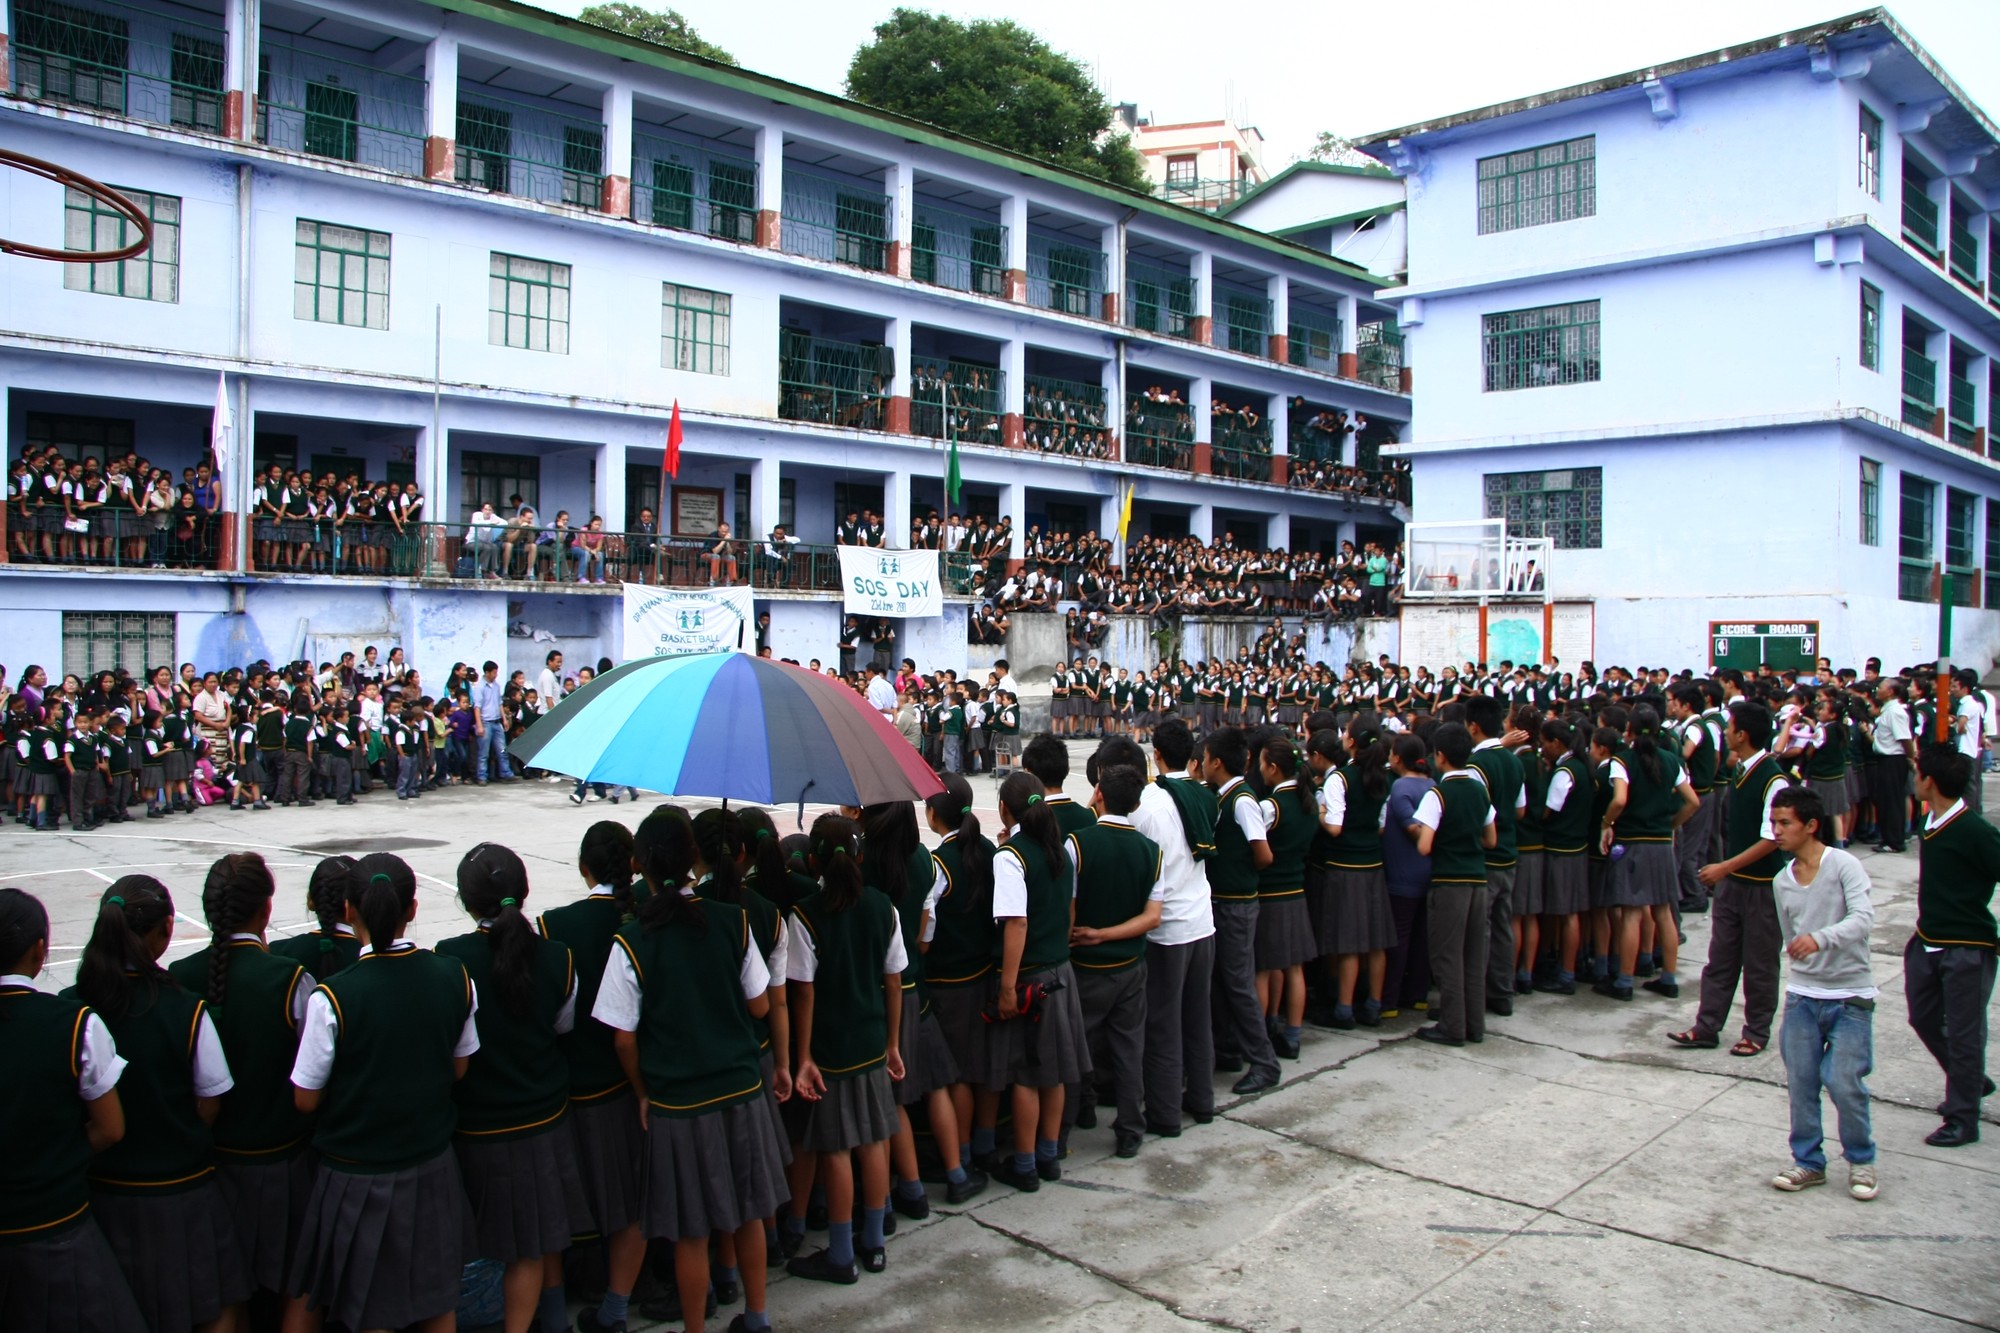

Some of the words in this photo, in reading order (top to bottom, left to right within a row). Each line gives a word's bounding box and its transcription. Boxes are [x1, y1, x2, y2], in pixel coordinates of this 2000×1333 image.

[853, 576, 888, 597] SOS
[896, 580, 929, 598] DAY
[1720, 624, 1756, 634] SCORE
[1768, 624, 1807, 634] BOARD
[660, 633, 721, 644] BASKETBALL
[654, 646, 673, 656] SOS
